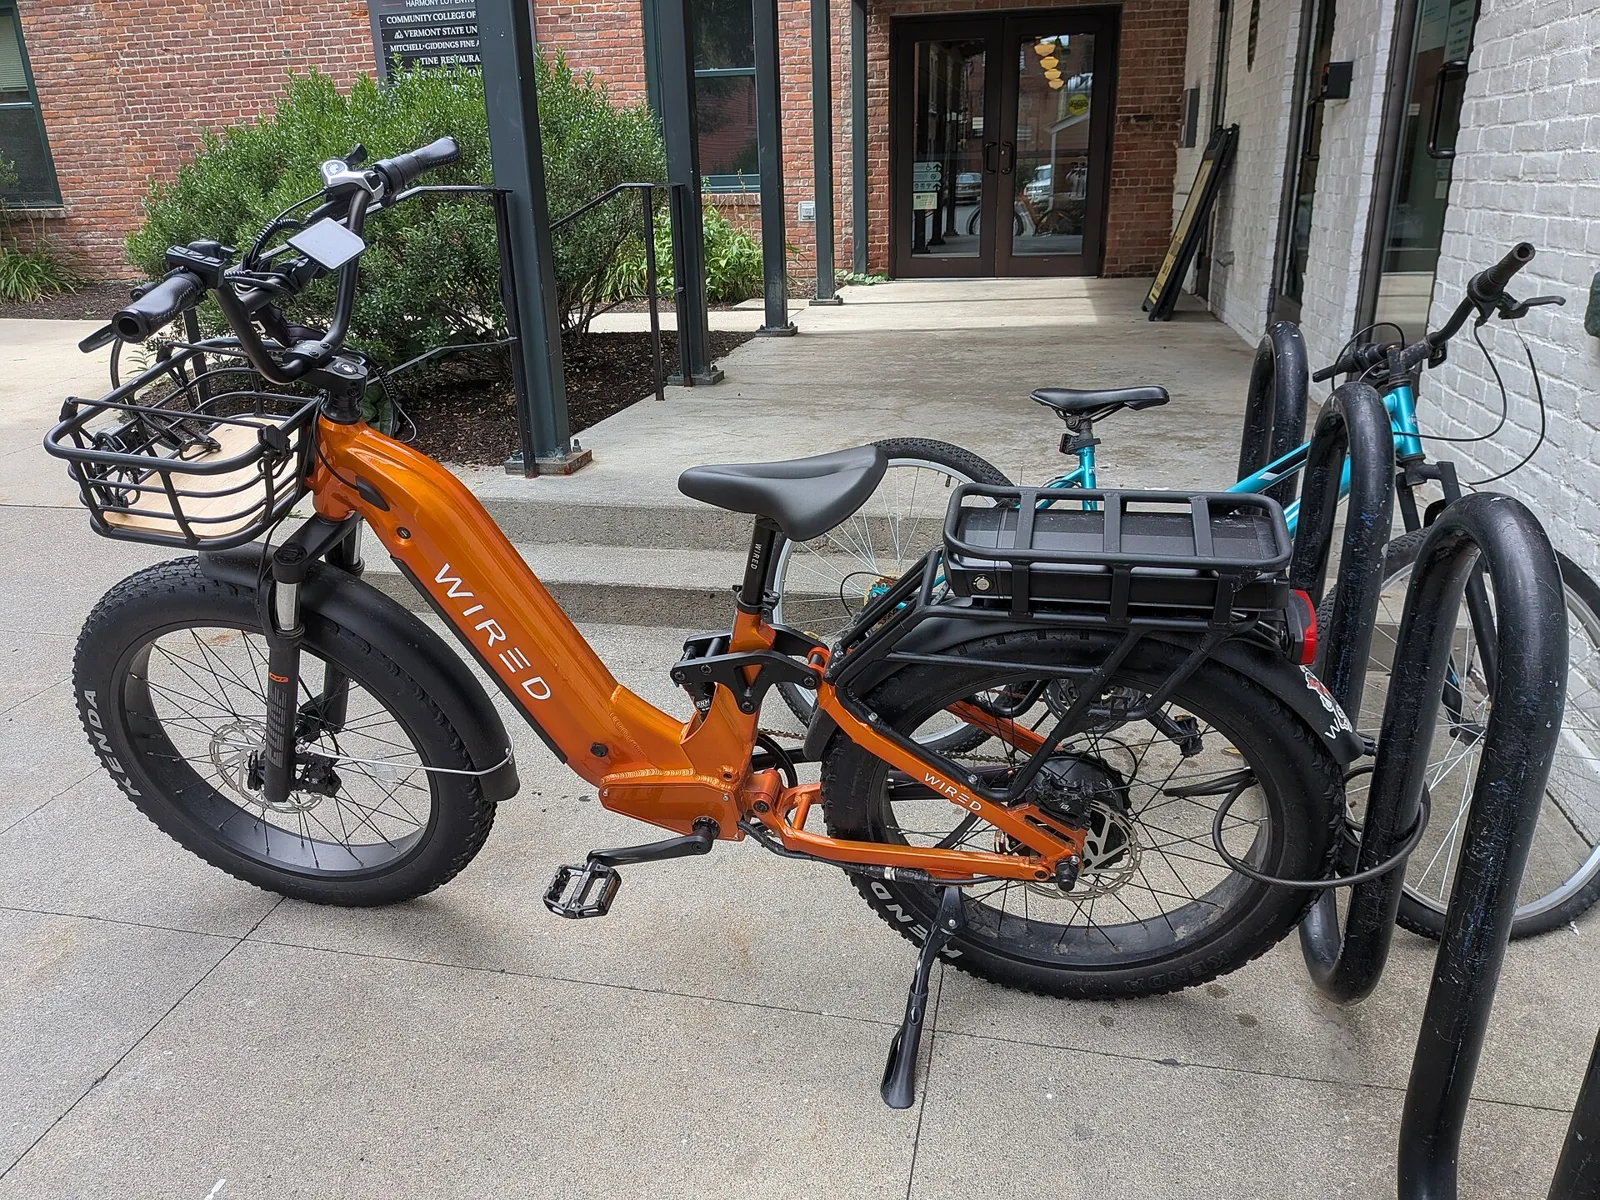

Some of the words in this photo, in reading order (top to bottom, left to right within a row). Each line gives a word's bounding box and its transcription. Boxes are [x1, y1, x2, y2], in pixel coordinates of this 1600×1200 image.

[386, 13, 432, 24] COMMUNITY
[432, 11, 465, 21] COLLEGE
[465, 10, 476, 19] OF
[403, 28, 441, 38] VERMONT
[442, 26, 465, 36] STATE
[466, 25, 478, 34] UN
[459, 40, 475, 48] FINE
[751, 543, 762, 570] WIRED
[434, 562, 551, 700] WIRED
[84, 690, 142, 796] KENDA
[924, 772, 982, 812] WIRED
[1124, 950, 1231, 992] KENDA
